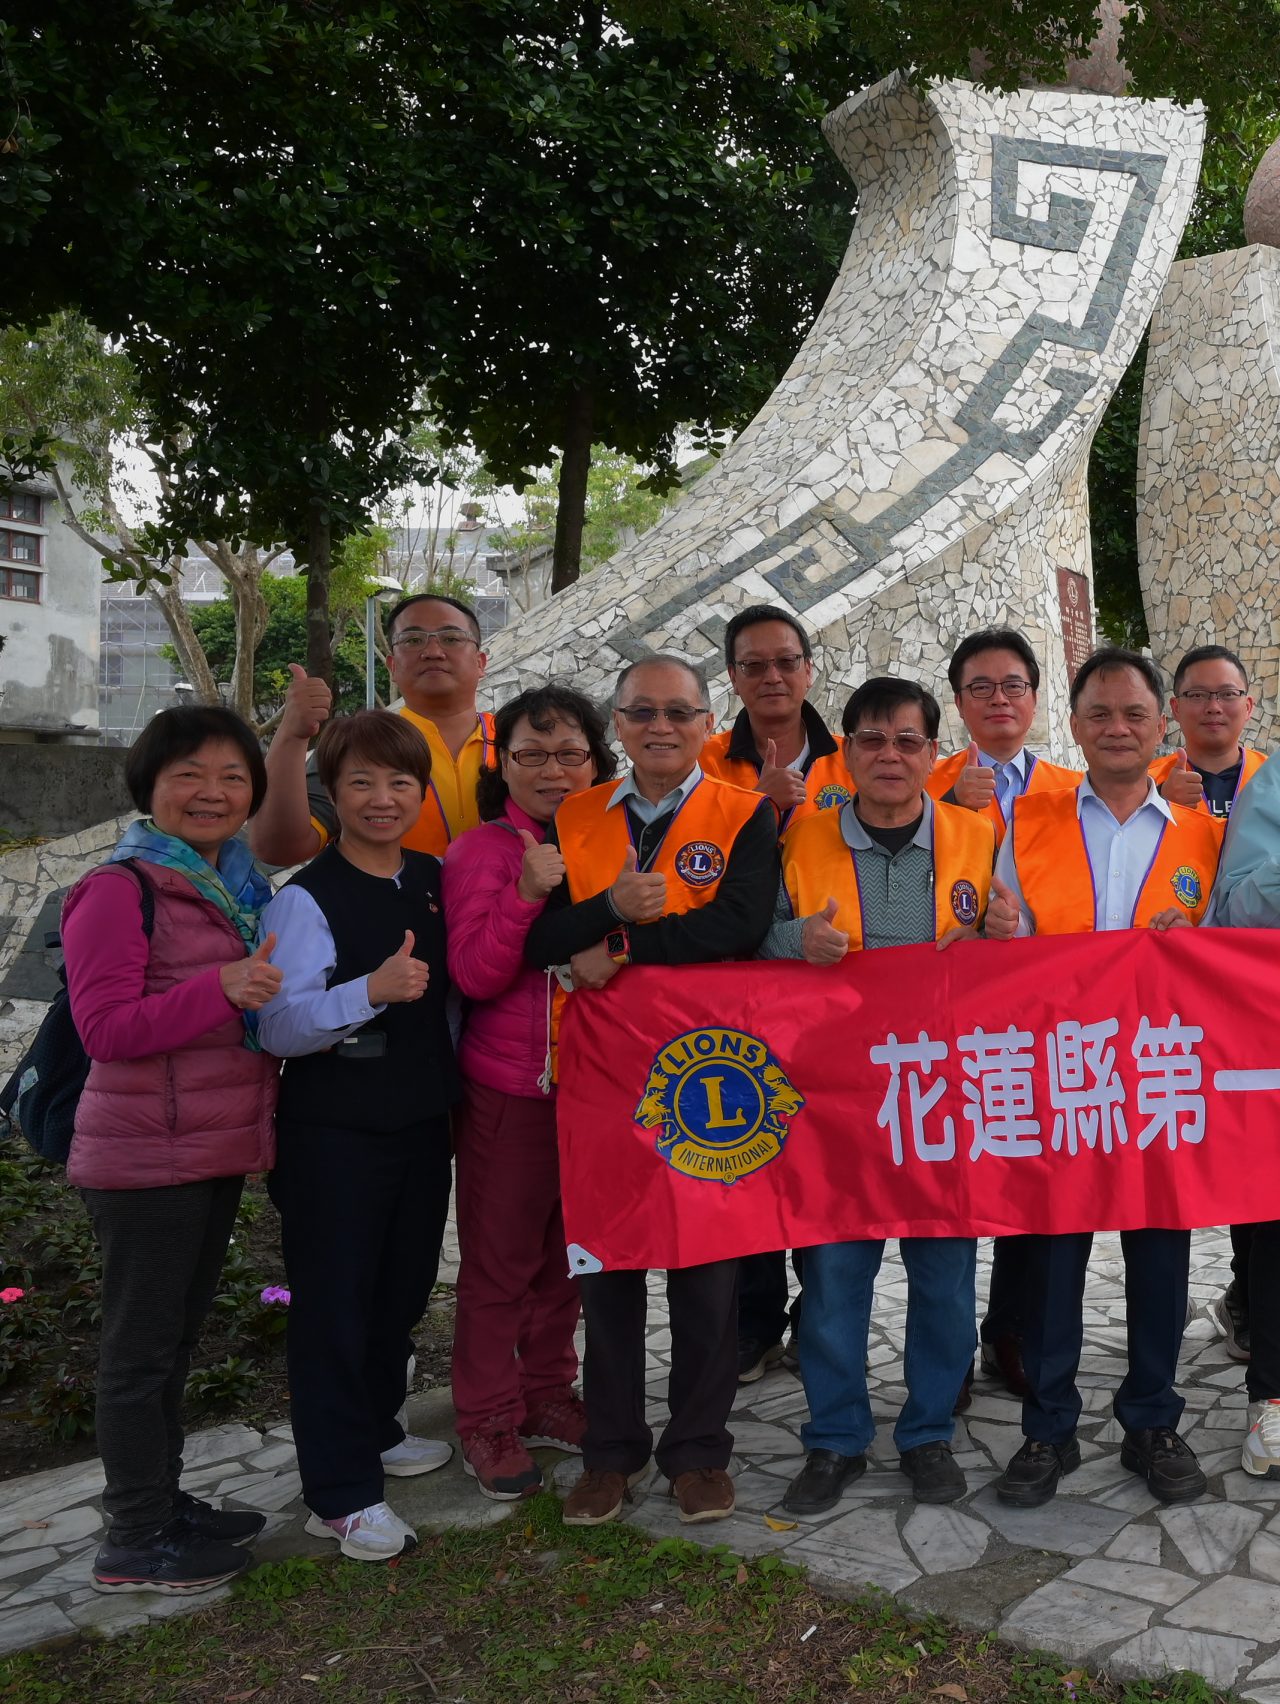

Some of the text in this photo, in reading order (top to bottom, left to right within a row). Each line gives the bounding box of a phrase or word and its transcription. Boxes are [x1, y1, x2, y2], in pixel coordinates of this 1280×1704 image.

[825, 785, 848, 797] LIONS
[690, 844, 714, 854] LIONS
[692, 854, 706, 871] L
[961, 893, 970, 910] L
[664, 1033, 761, 1070] LIONS
[699, 1076, 747, 1129] L
[678, 1138, 773, 1172] INTERNATIONAL
